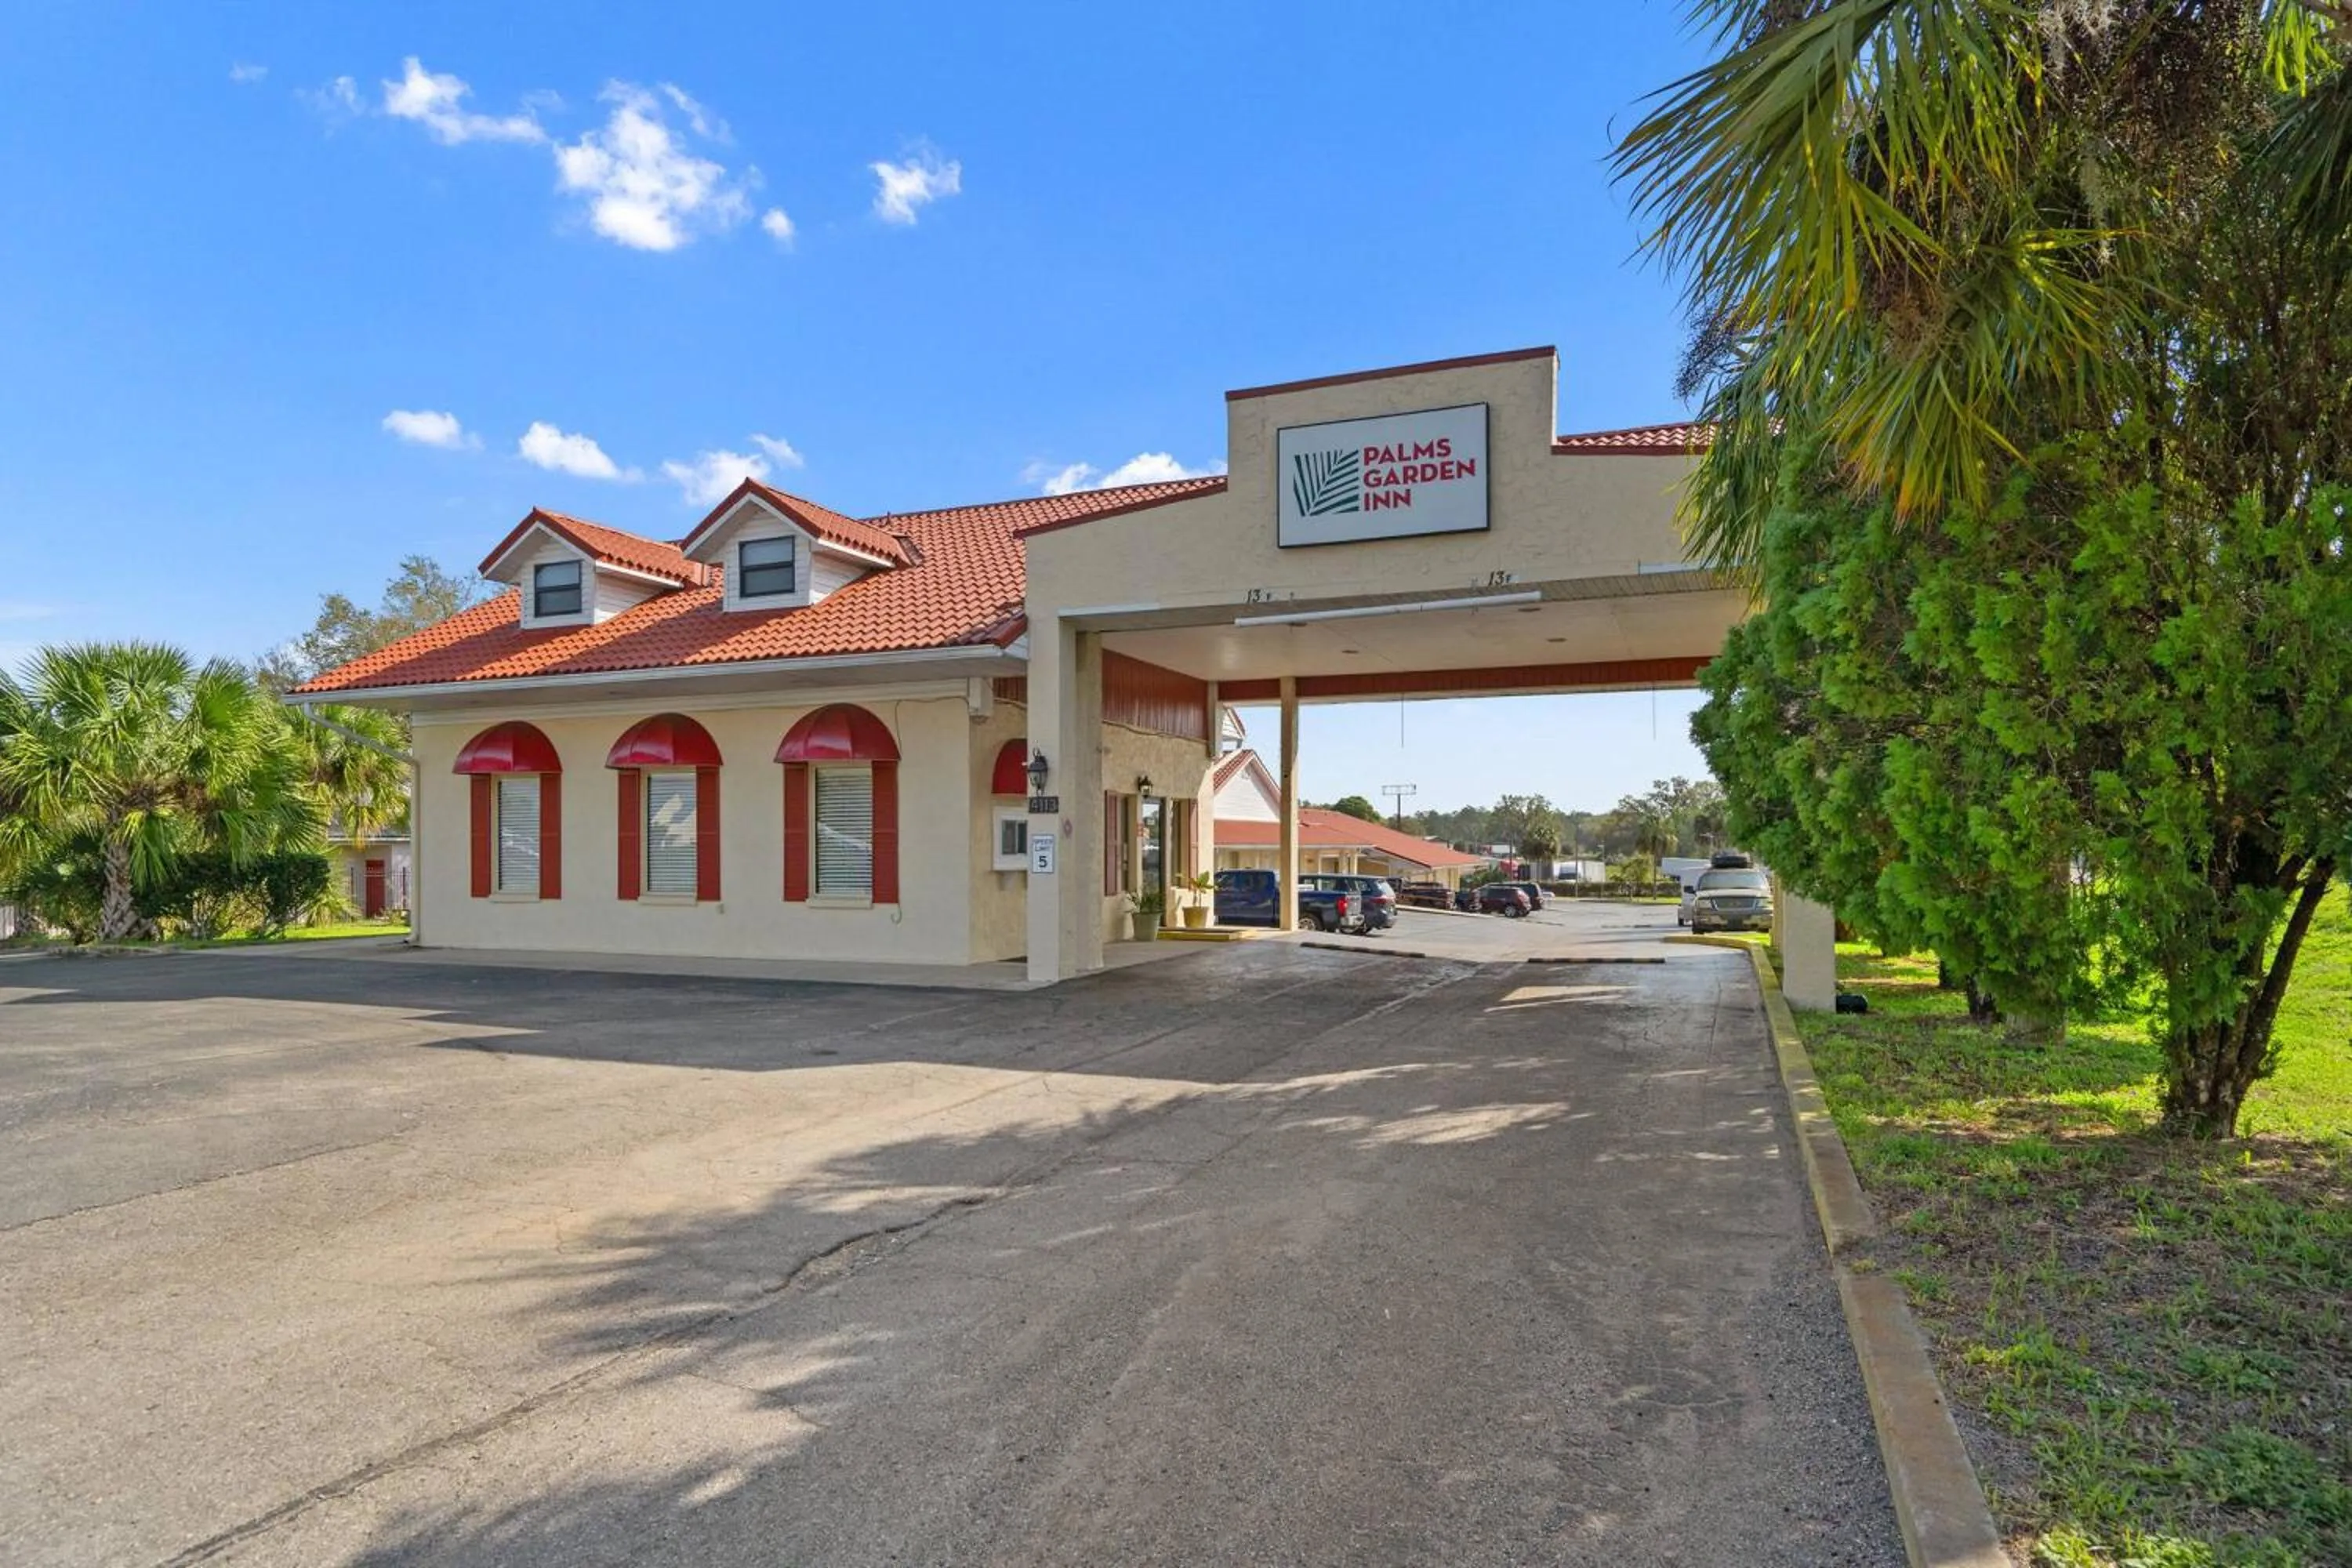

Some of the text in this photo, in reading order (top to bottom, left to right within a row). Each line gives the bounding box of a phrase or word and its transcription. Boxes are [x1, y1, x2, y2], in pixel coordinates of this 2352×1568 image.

[1363, 438, 1451, 466] PALMS
[1363, 459, 1475, 488] GARDEN
[1363, 489, 1411, 512] INN
[1039, 855, 1047, 868] 5
